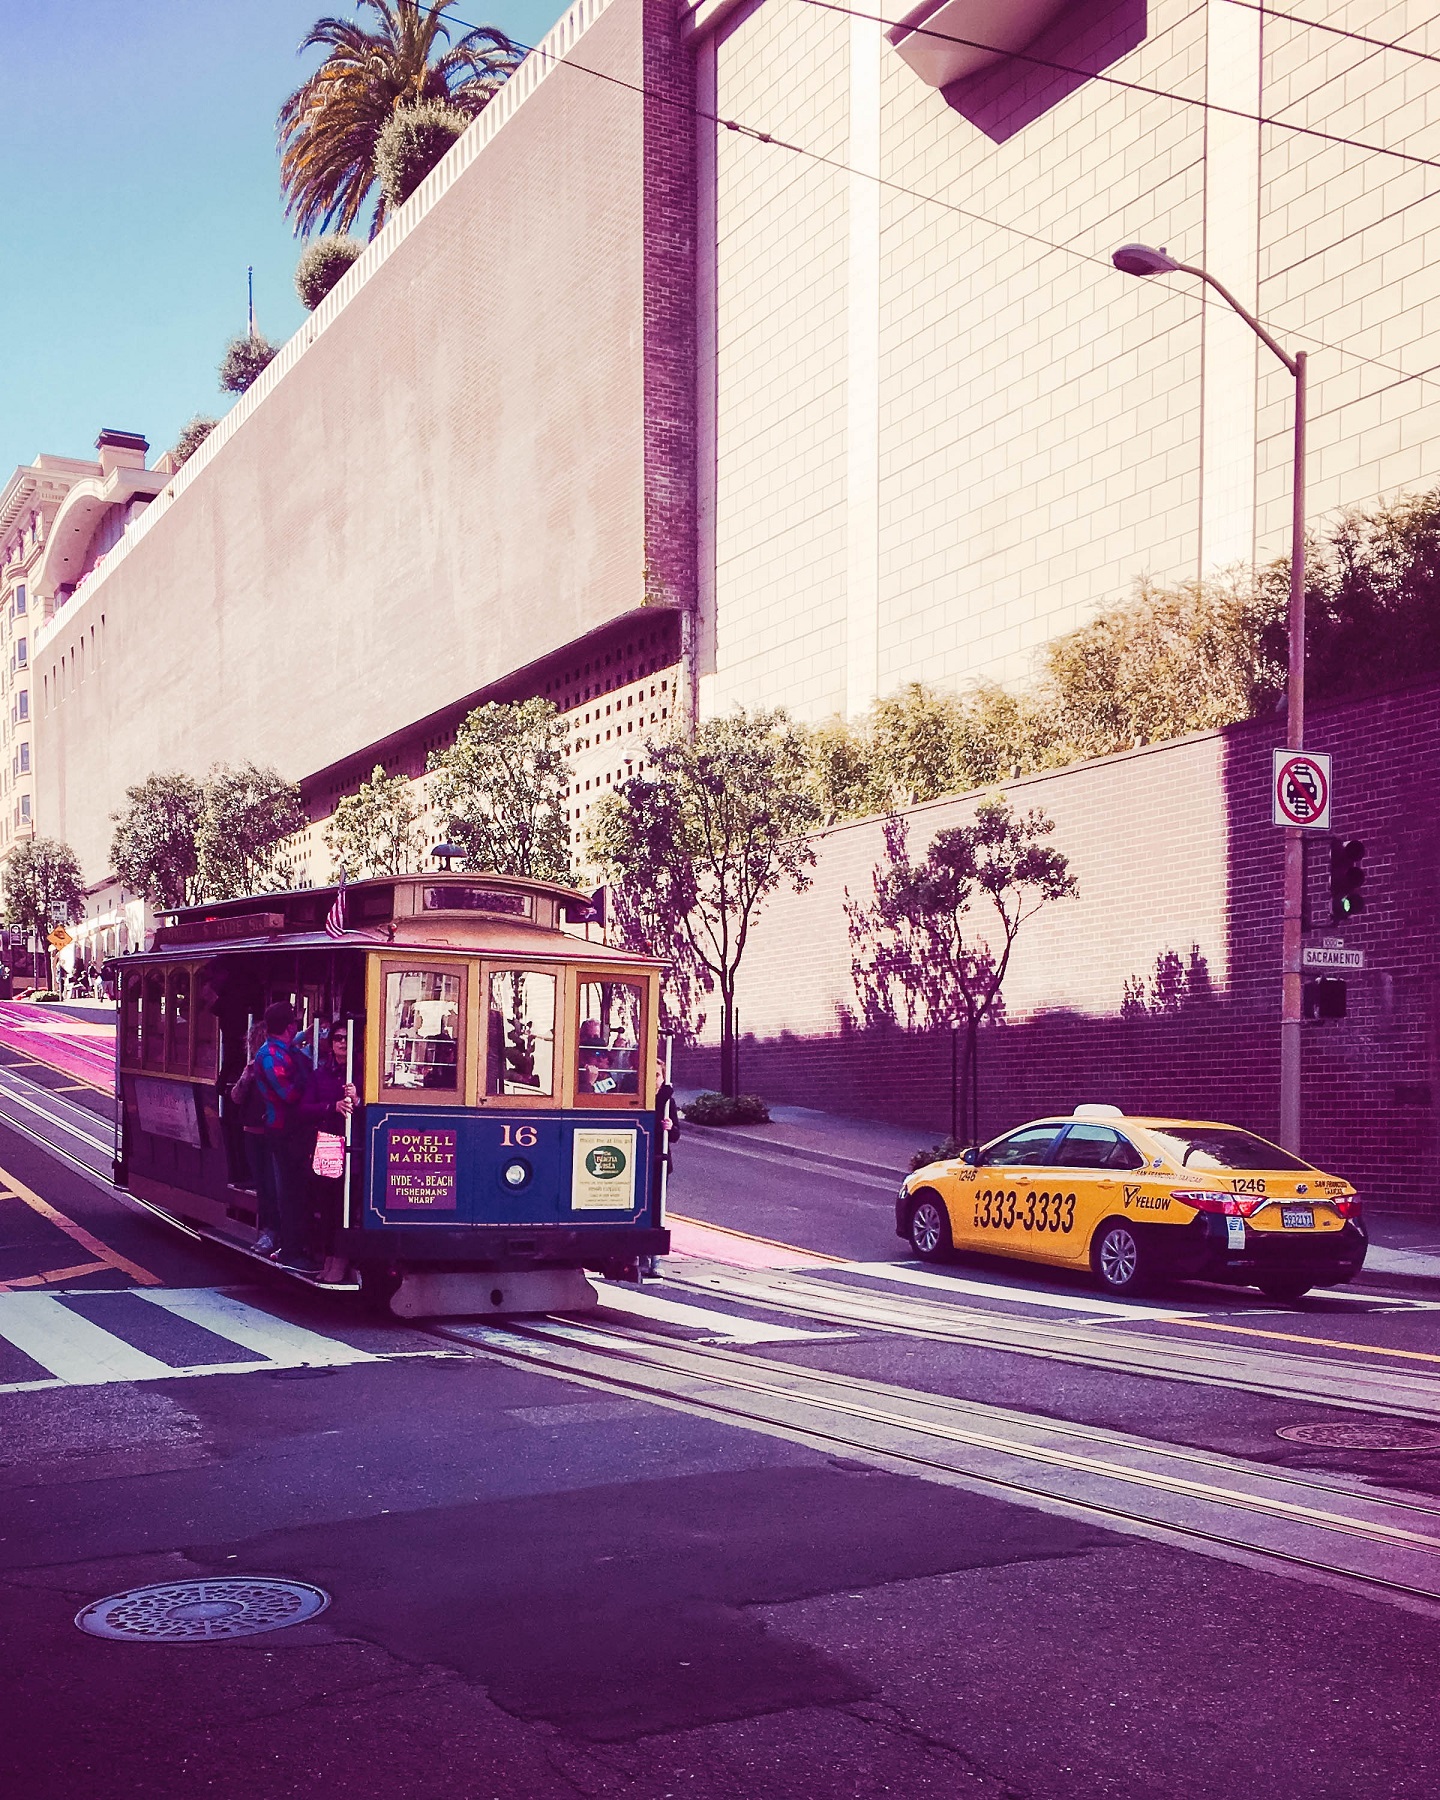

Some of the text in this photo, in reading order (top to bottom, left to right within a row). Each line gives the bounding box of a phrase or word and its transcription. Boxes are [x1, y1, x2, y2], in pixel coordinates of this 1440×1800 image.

[1306, 951, 1360, 965] SACRAMENTO
[391, 1135, 454, 1146] POWELL
[500, 1124, 538, 1147] 16
[407, 1145, 438, 1153] AND
[389, 1152, 454, 1163] MARKET
[390, 1175, 413, 1186] HYDE
[425, 1175, 454, 1187] BEACH
[958, 1169, 978, 1181] 1246
[1231, 1179, 1266, 1193] 1246
[1314, 1180, 1326, 1188] SAN
[395, 1187, 448, 1196] FISHERMANS
[408, 1196, 436, 1204] WHARF
[1135, 1196, 1171, 1211] YELLOW
[980, 1189, 1077, 1234] 333-3333
